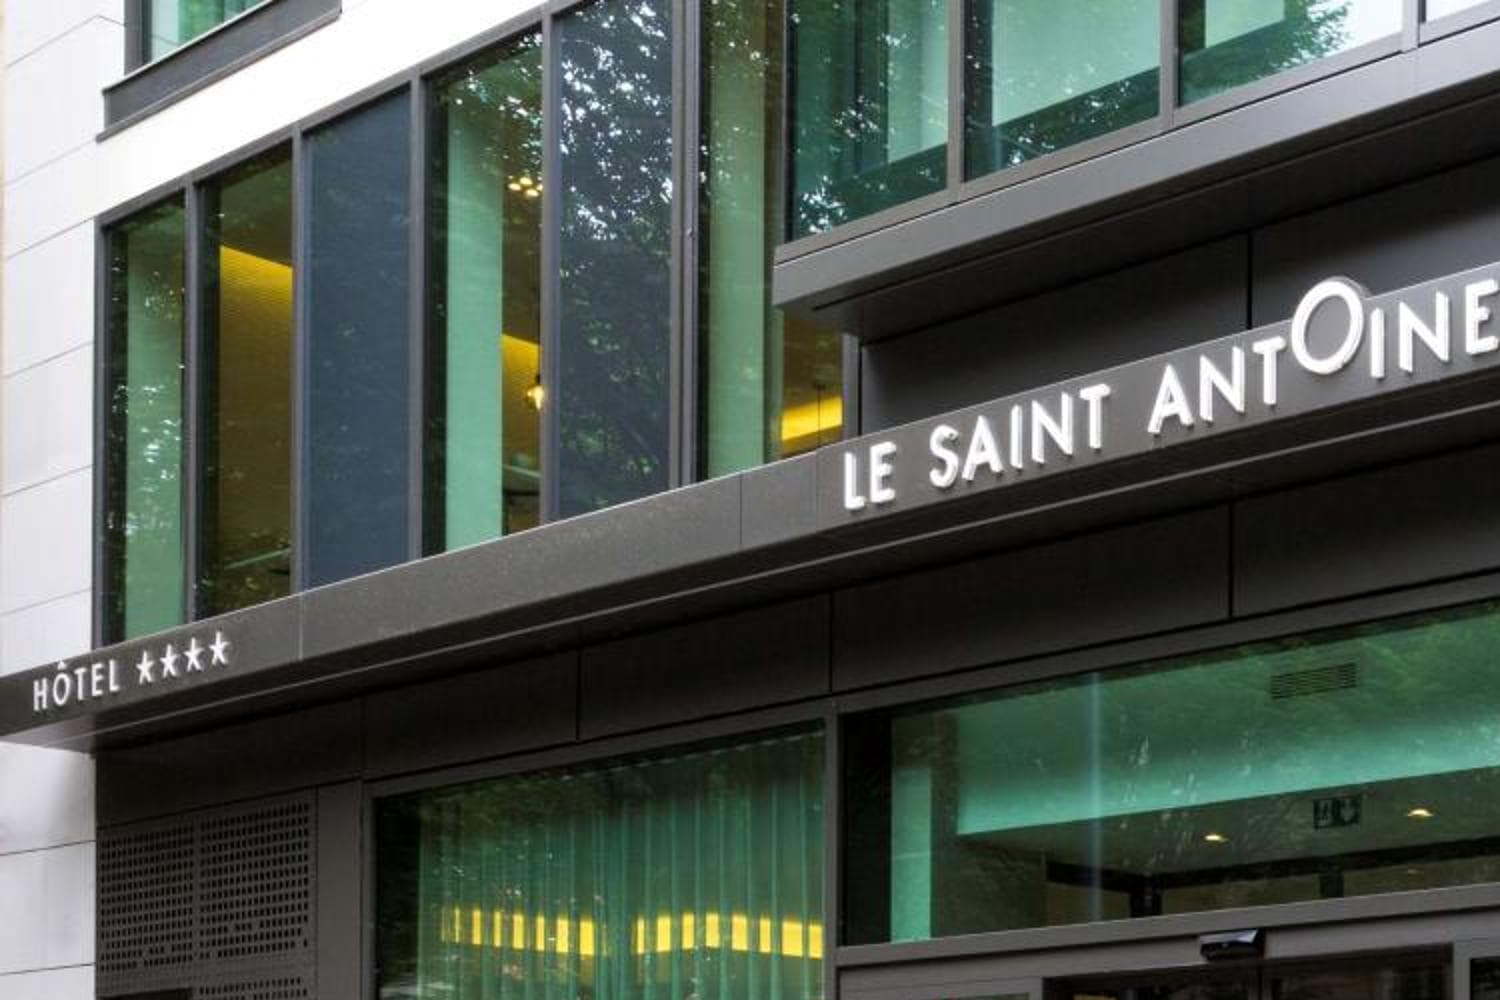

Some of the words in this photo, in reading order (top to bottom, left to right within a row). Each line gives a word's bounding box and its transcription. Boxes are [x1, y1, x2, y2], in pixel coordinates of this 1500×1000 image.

[842, 440, 897, 511] LE
[929, 382, 1112, 489] SAINT
[1147, 275, 1500, 436] ANTOINE
[32, 659, 121, 712] HÔTEL
